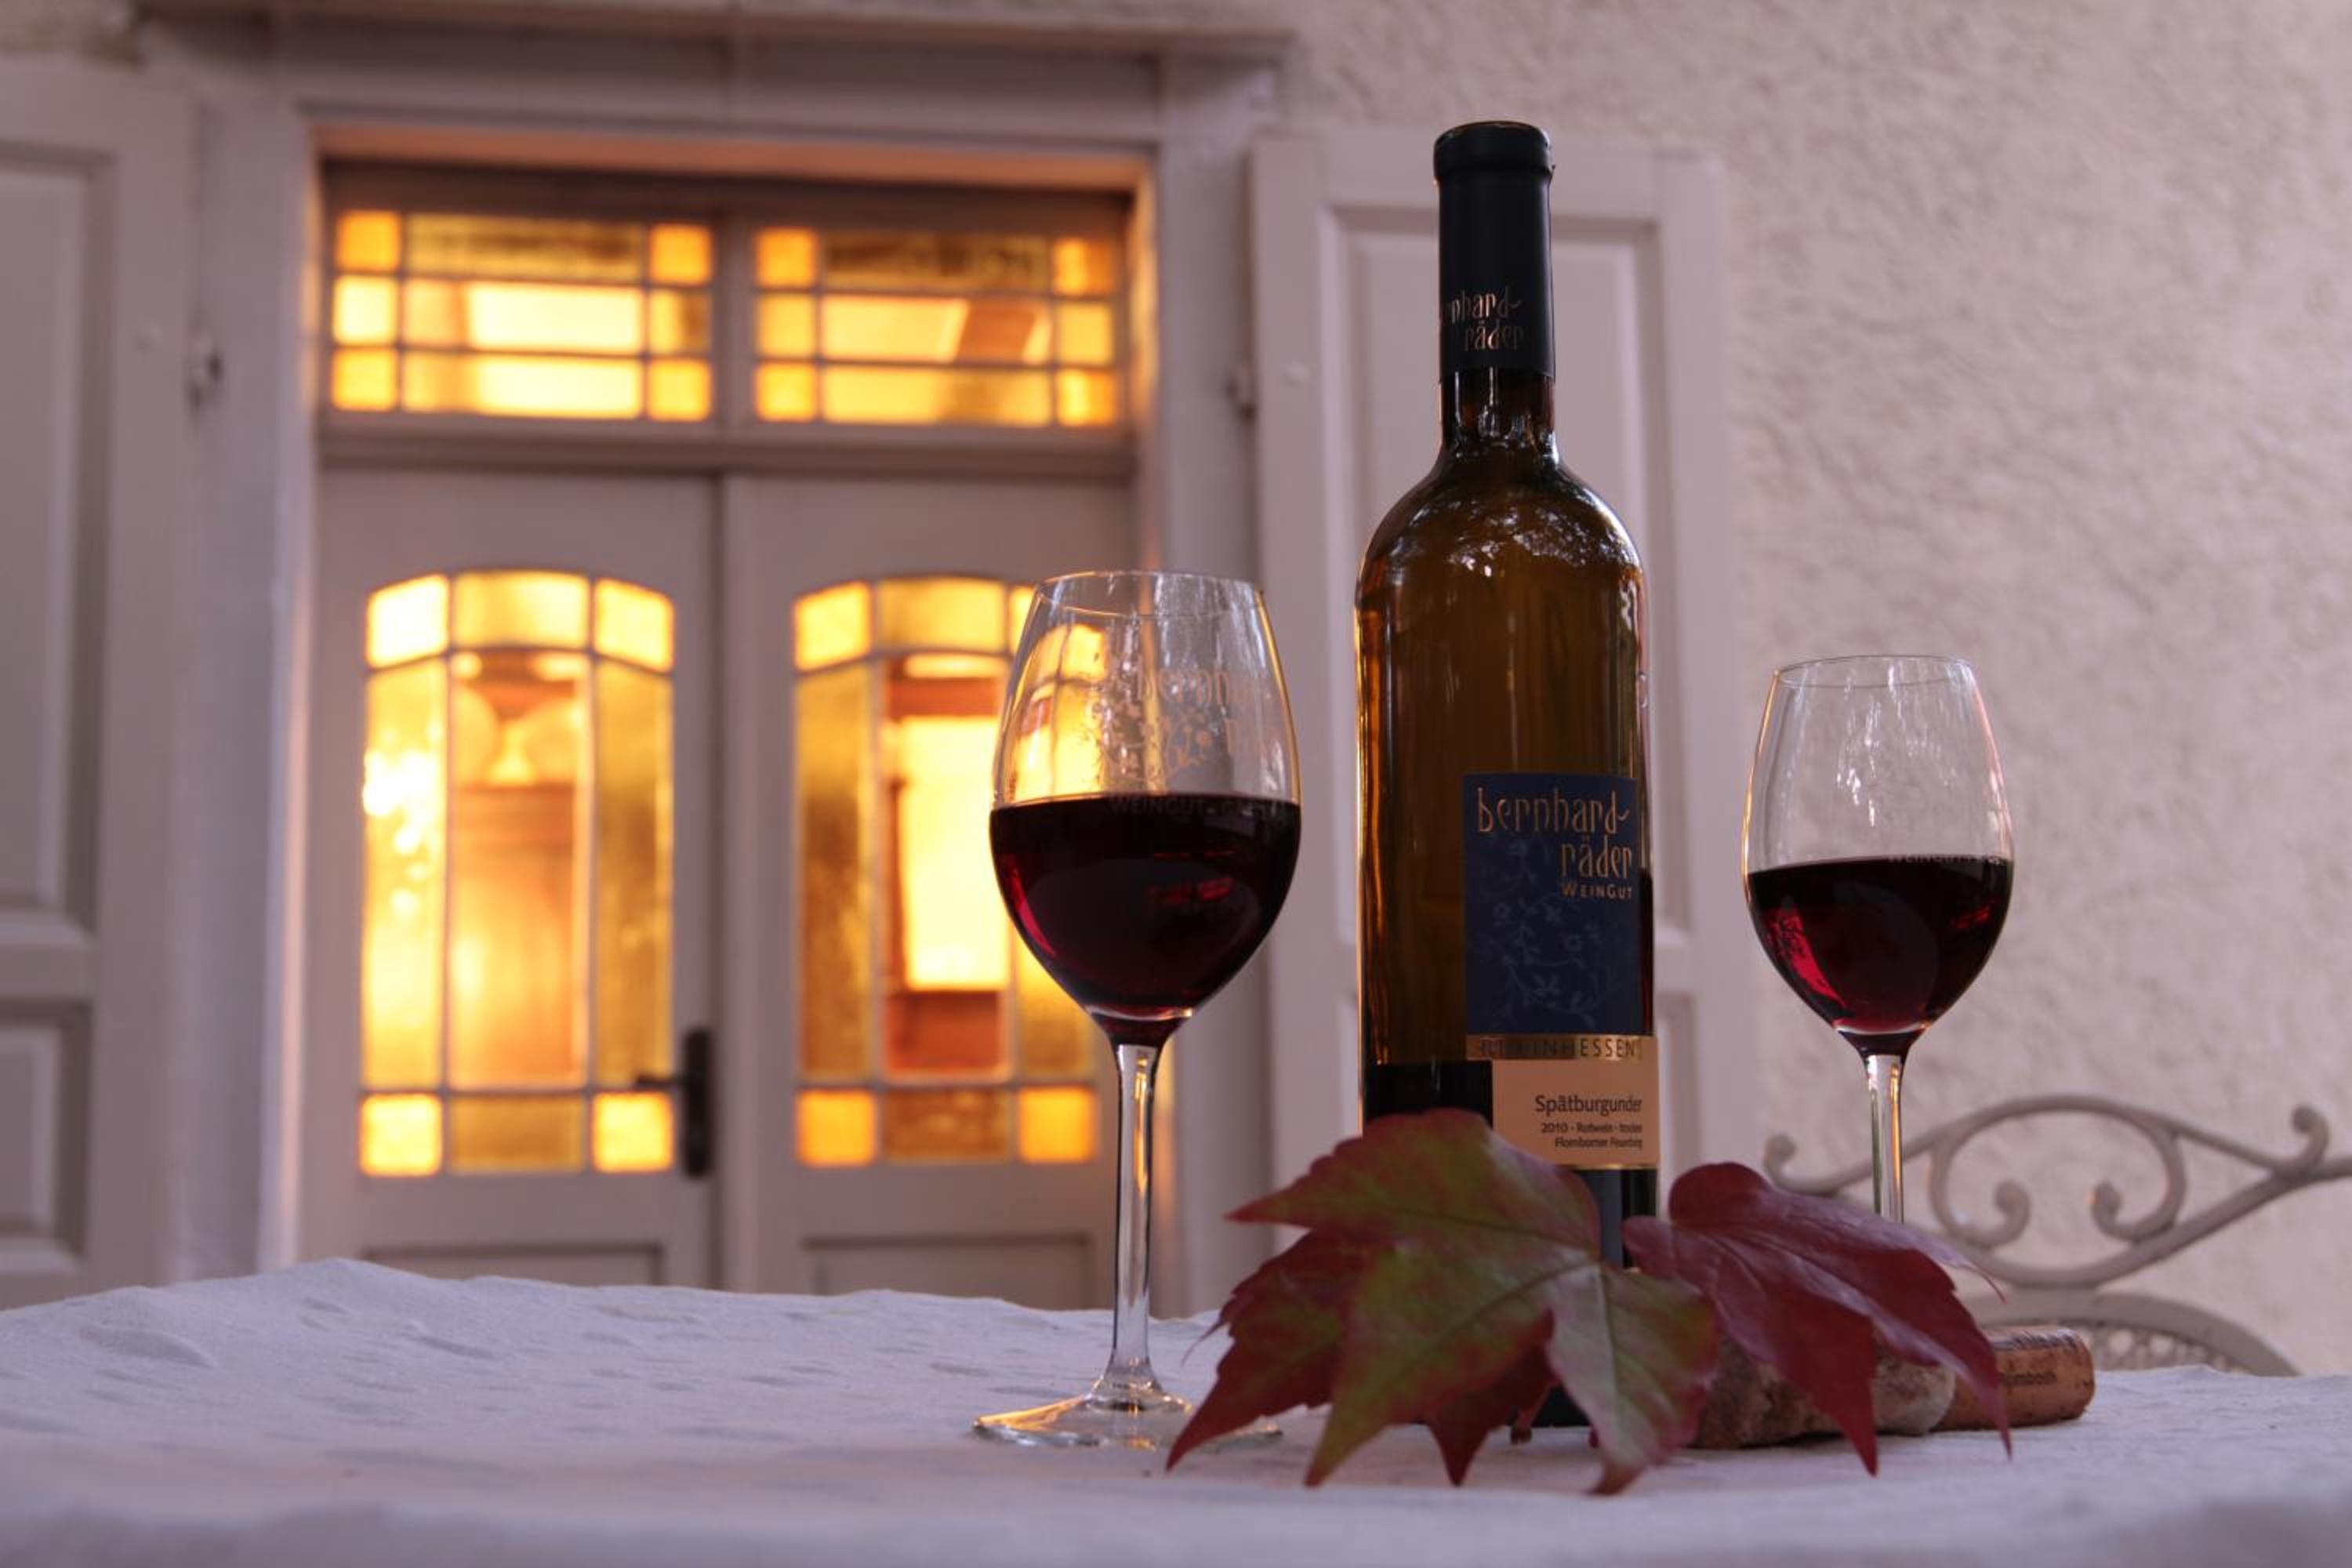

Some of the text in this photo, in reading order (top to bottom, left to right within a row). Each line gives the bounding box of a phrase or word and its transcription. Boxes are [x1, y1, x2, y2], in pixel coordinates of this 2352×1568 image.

[1477, 786, 1631, 834] bernhard
[1559, 834, 1632, 879] räder
[1534, 1094, 1642, 1116] Spätburgunder
[1541, 1122, 1569, 1134] 2010
